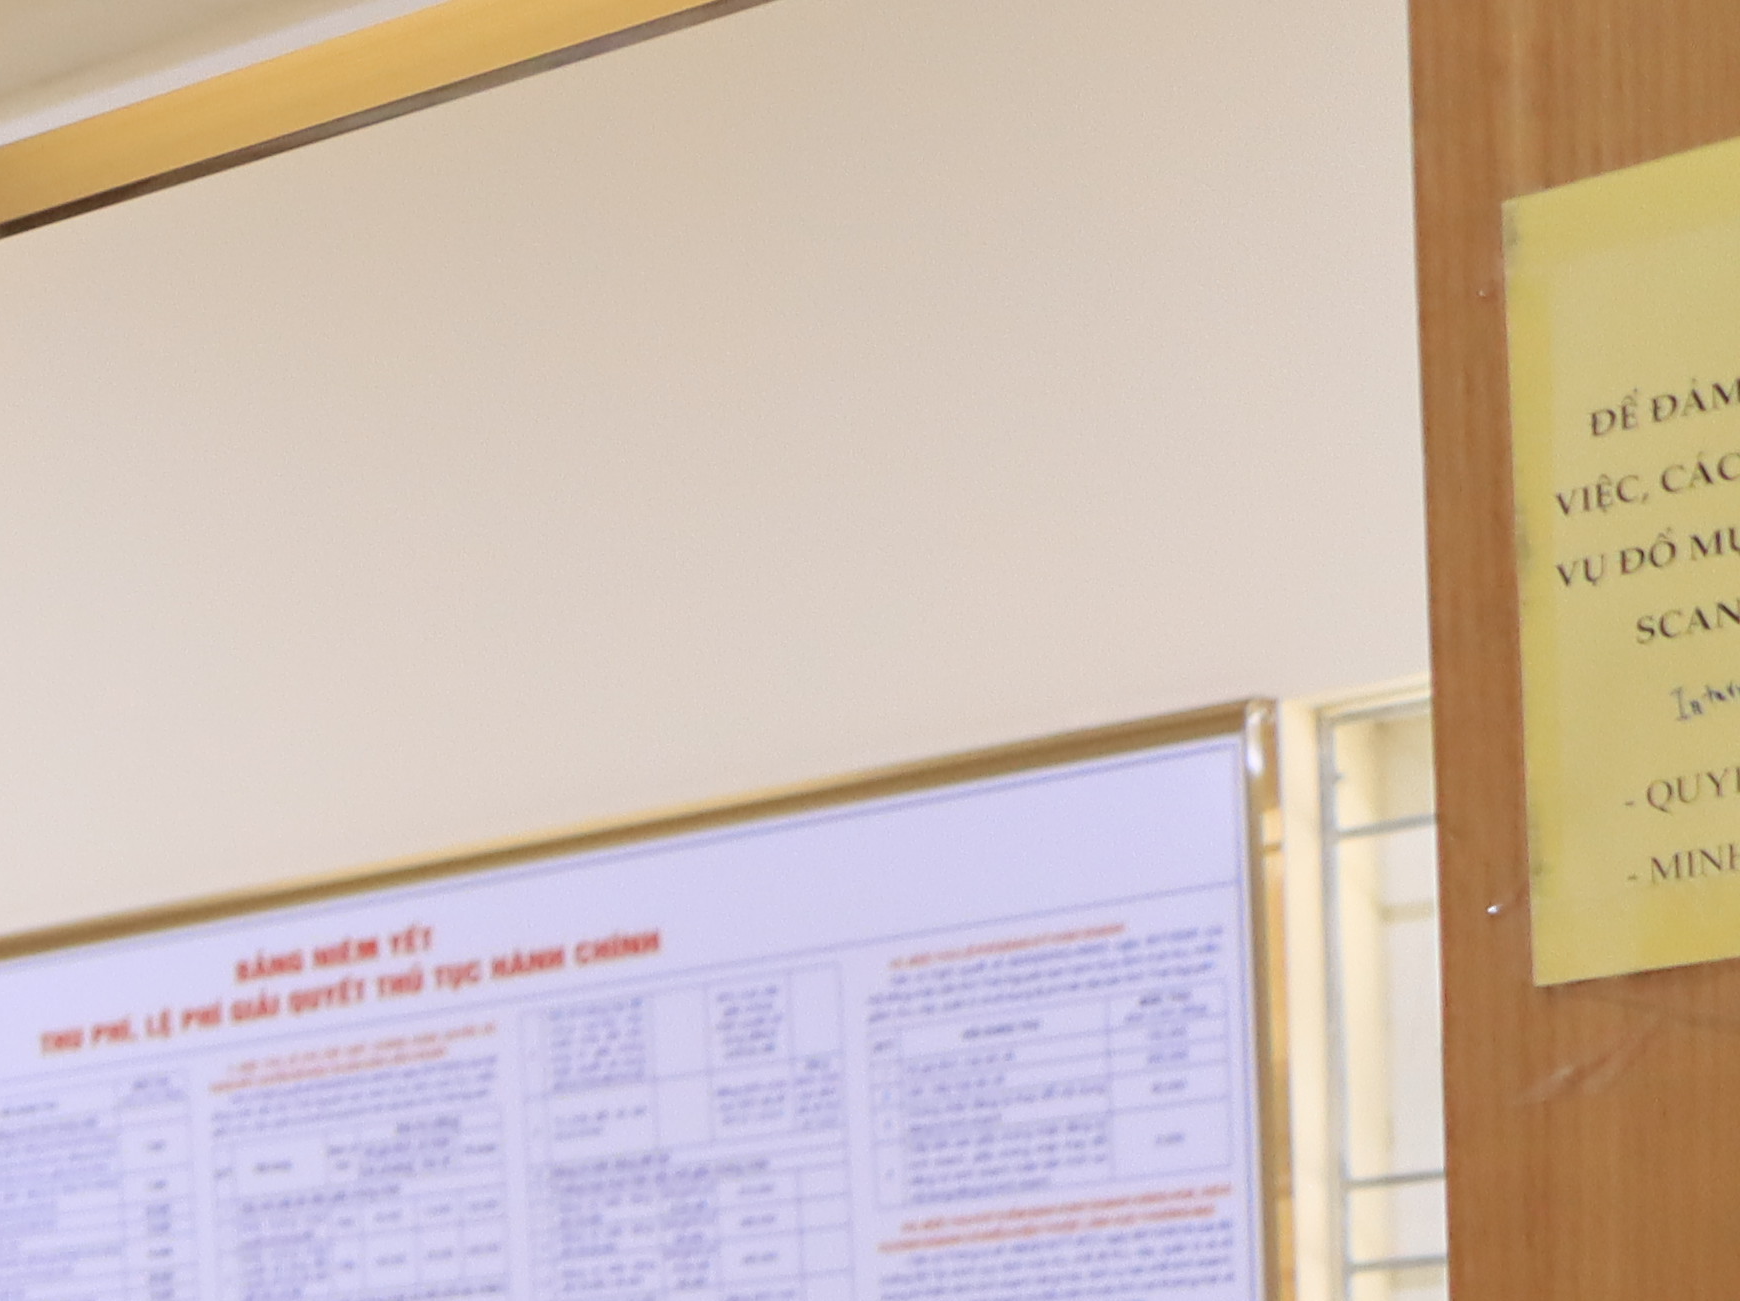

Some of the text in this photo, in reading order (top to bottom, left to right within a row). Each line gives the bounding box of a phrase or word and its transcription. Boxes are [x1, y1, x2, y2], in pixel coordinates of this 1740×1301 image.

[1555, 451, 1740, 516] VIỆC, CÁC
[1556, 553, 1606, 587] VỤ
[1637, 598, 1740, 645] SCAN
